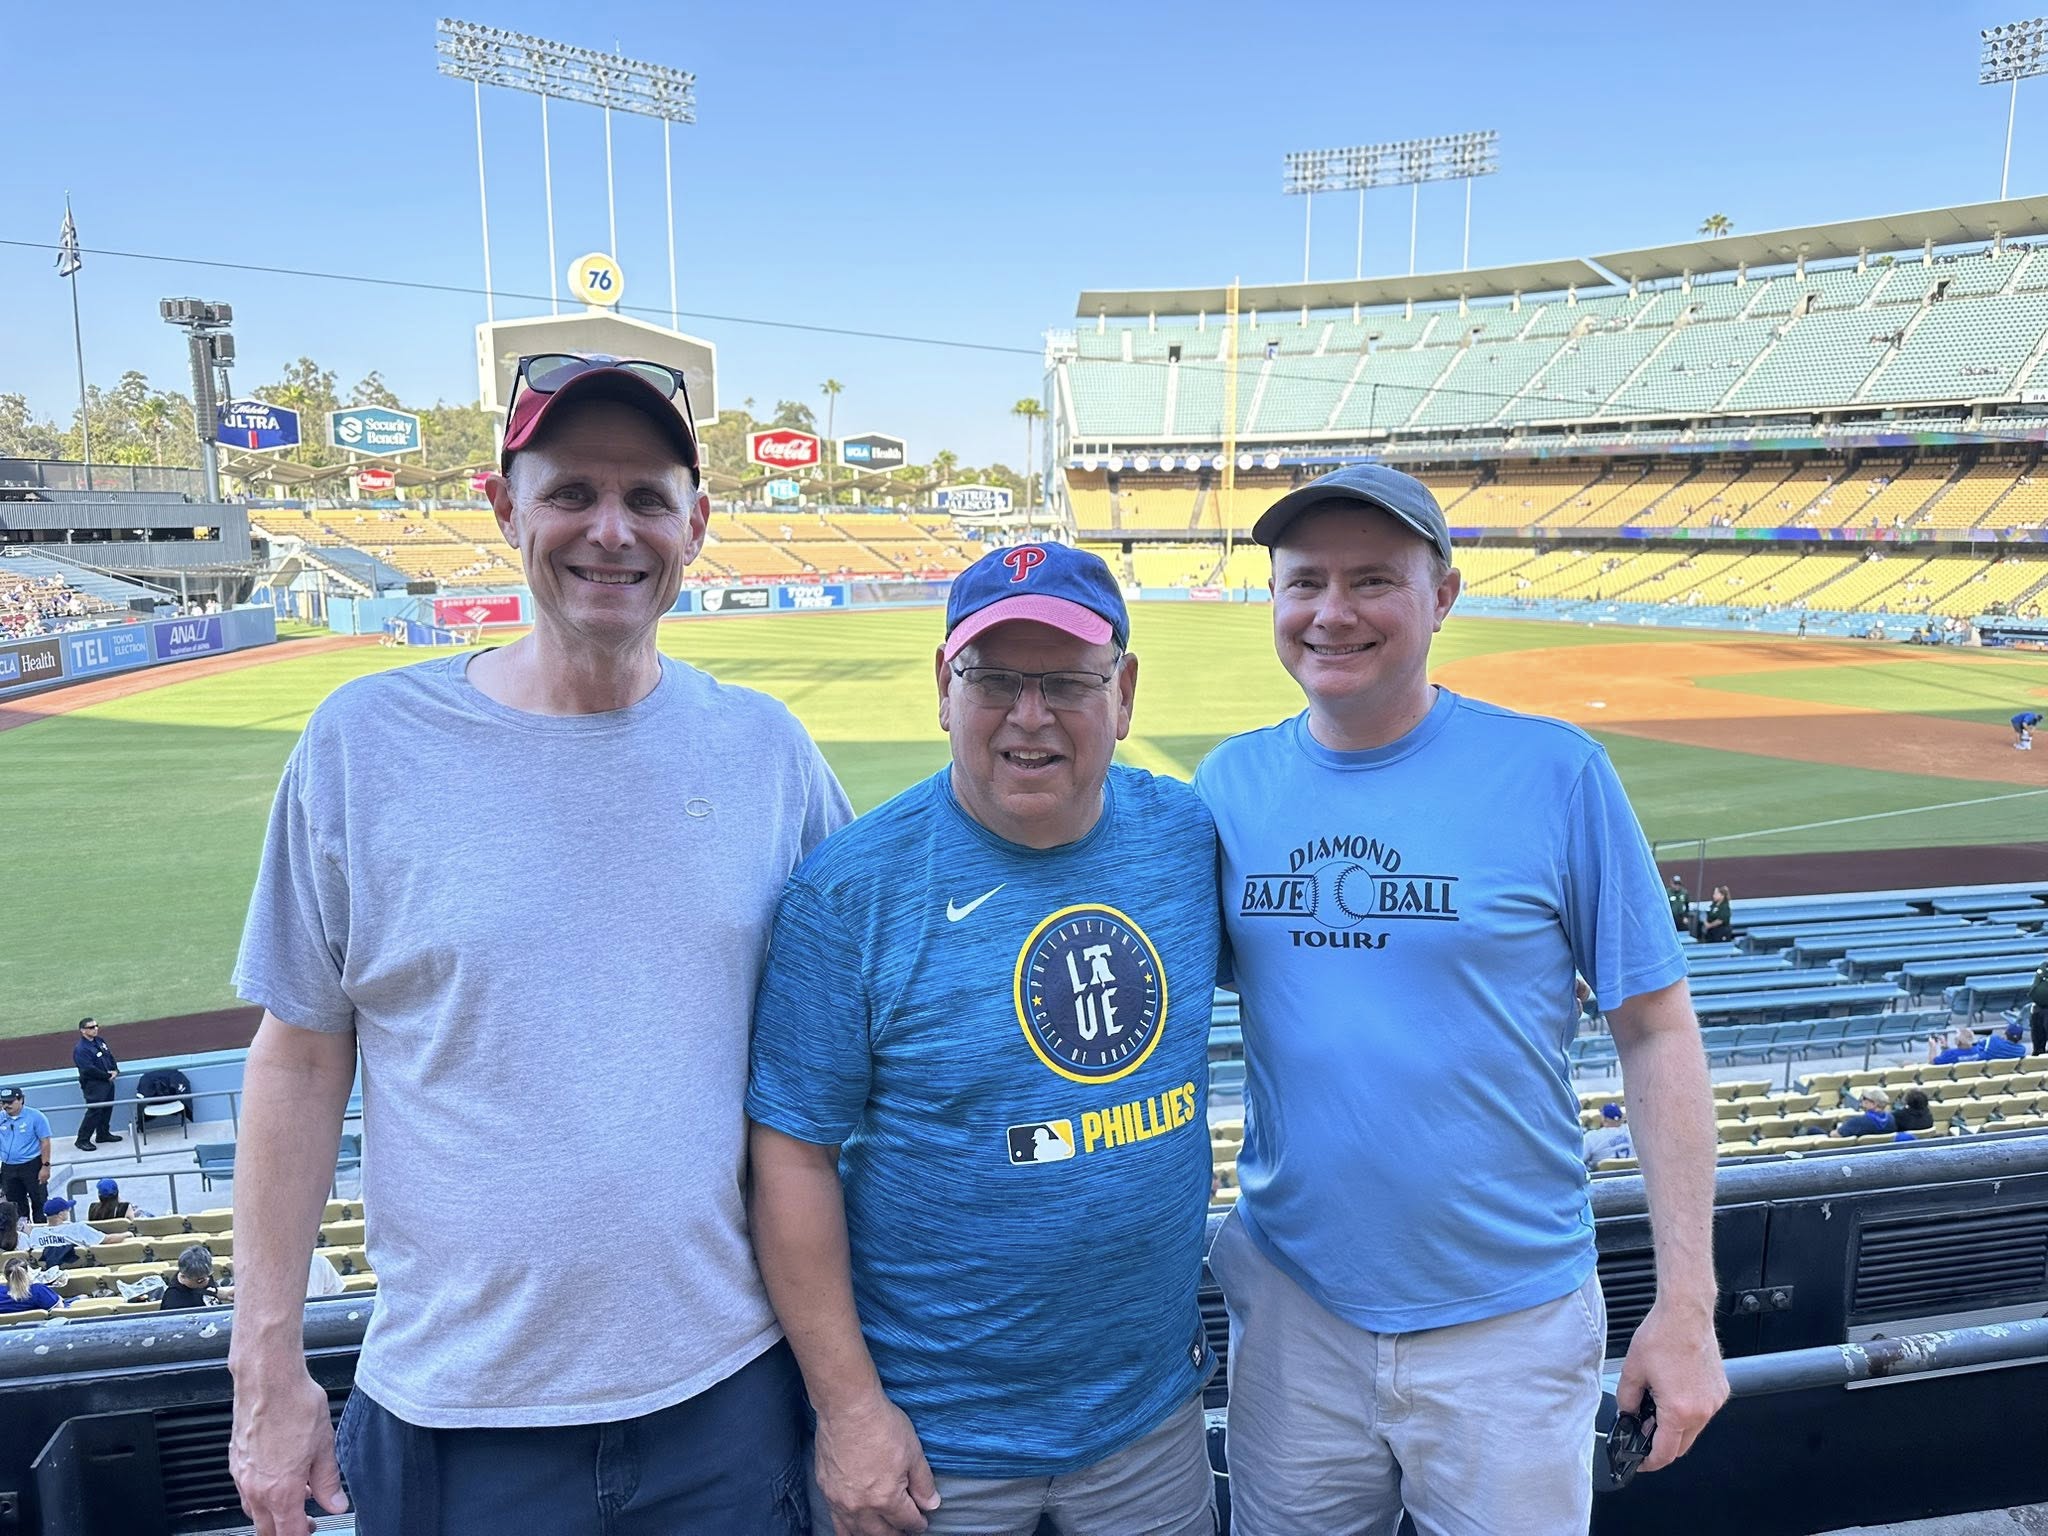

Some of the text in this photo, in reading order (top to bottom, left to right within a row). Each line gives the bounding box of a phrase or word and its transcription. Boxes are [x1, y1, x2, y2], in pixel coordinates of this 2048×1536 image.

[588, 269, 612, 291] 76
[225, 414, 280, 430] ULTRA
[364, 417, 413, 435] Security
[366, 431, 409, 445] Benefit
[757, 437, 814, 460] Coca-Cola
[845, 445, 902, 459] UCLA Health
[1003, 546, 1047, 583] P
[787, 585, 824, 598] TOYO
[112, 633, 134, 645] TOKYO
[169, 623, 197, 646] ANA
[71, 638, 109, 668] TEL
[115, 642, 146, 656] ELECTRON
[0, 650, 56, 676] CLA Health
[1289, 834, 1402, 874] DIAMOND
[1287, 930, 1392, 950] TOURS
[1030, 920, 1148, 988] PHILADELPHIA
[1035, 988, 1156, 1065] CITY OF BROTHERLY
[1081, 1081, 1196, 1154] PHILLIES
[38, 1235, 66, 1247] OHTANI
